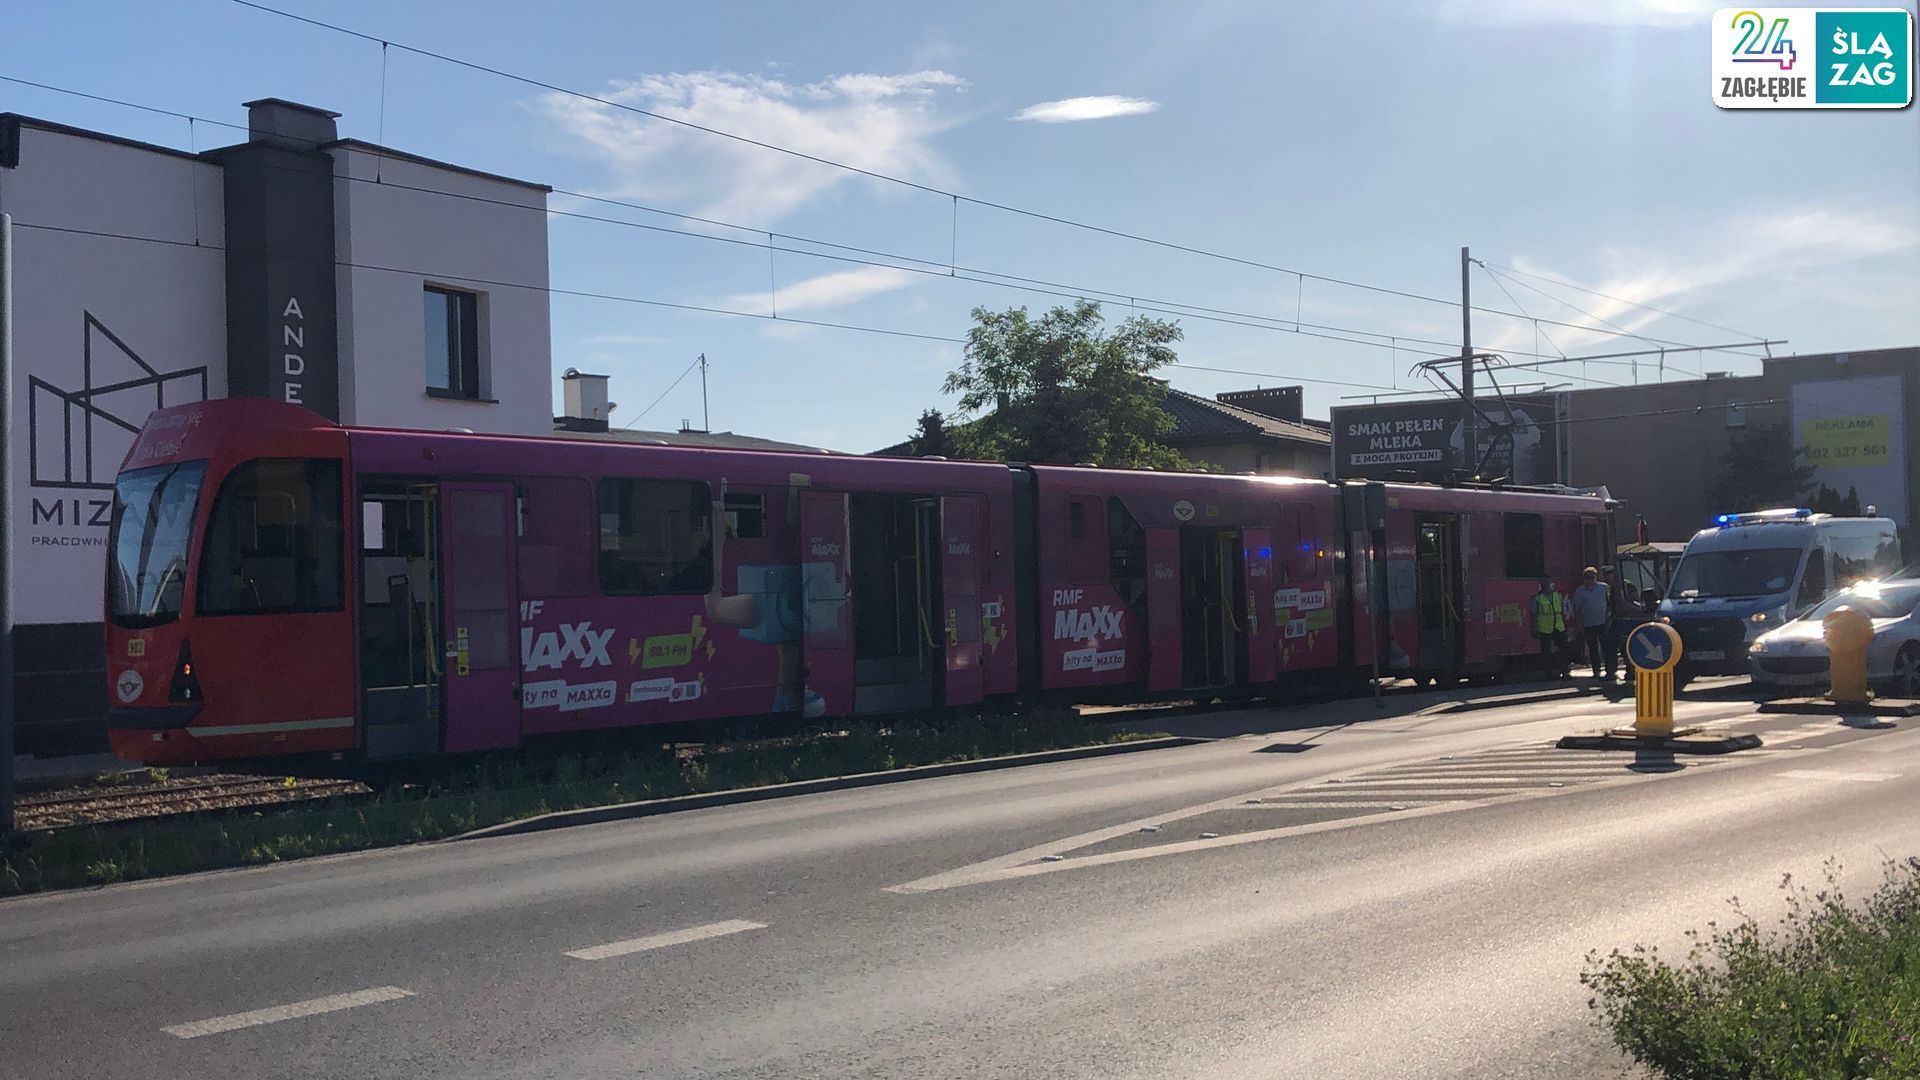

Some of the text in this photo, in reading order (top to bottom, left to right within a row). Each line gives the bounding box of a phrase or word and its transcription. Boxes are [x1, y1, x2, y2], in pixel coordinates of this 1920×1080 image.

[1349, 418, 1444, 436] SMAK PEŁEN
[1369, 435, 1422, 450] MLEKA
[1355, 455, 1362, 463] Z
[1053, 589, 1083, 606] RMF
